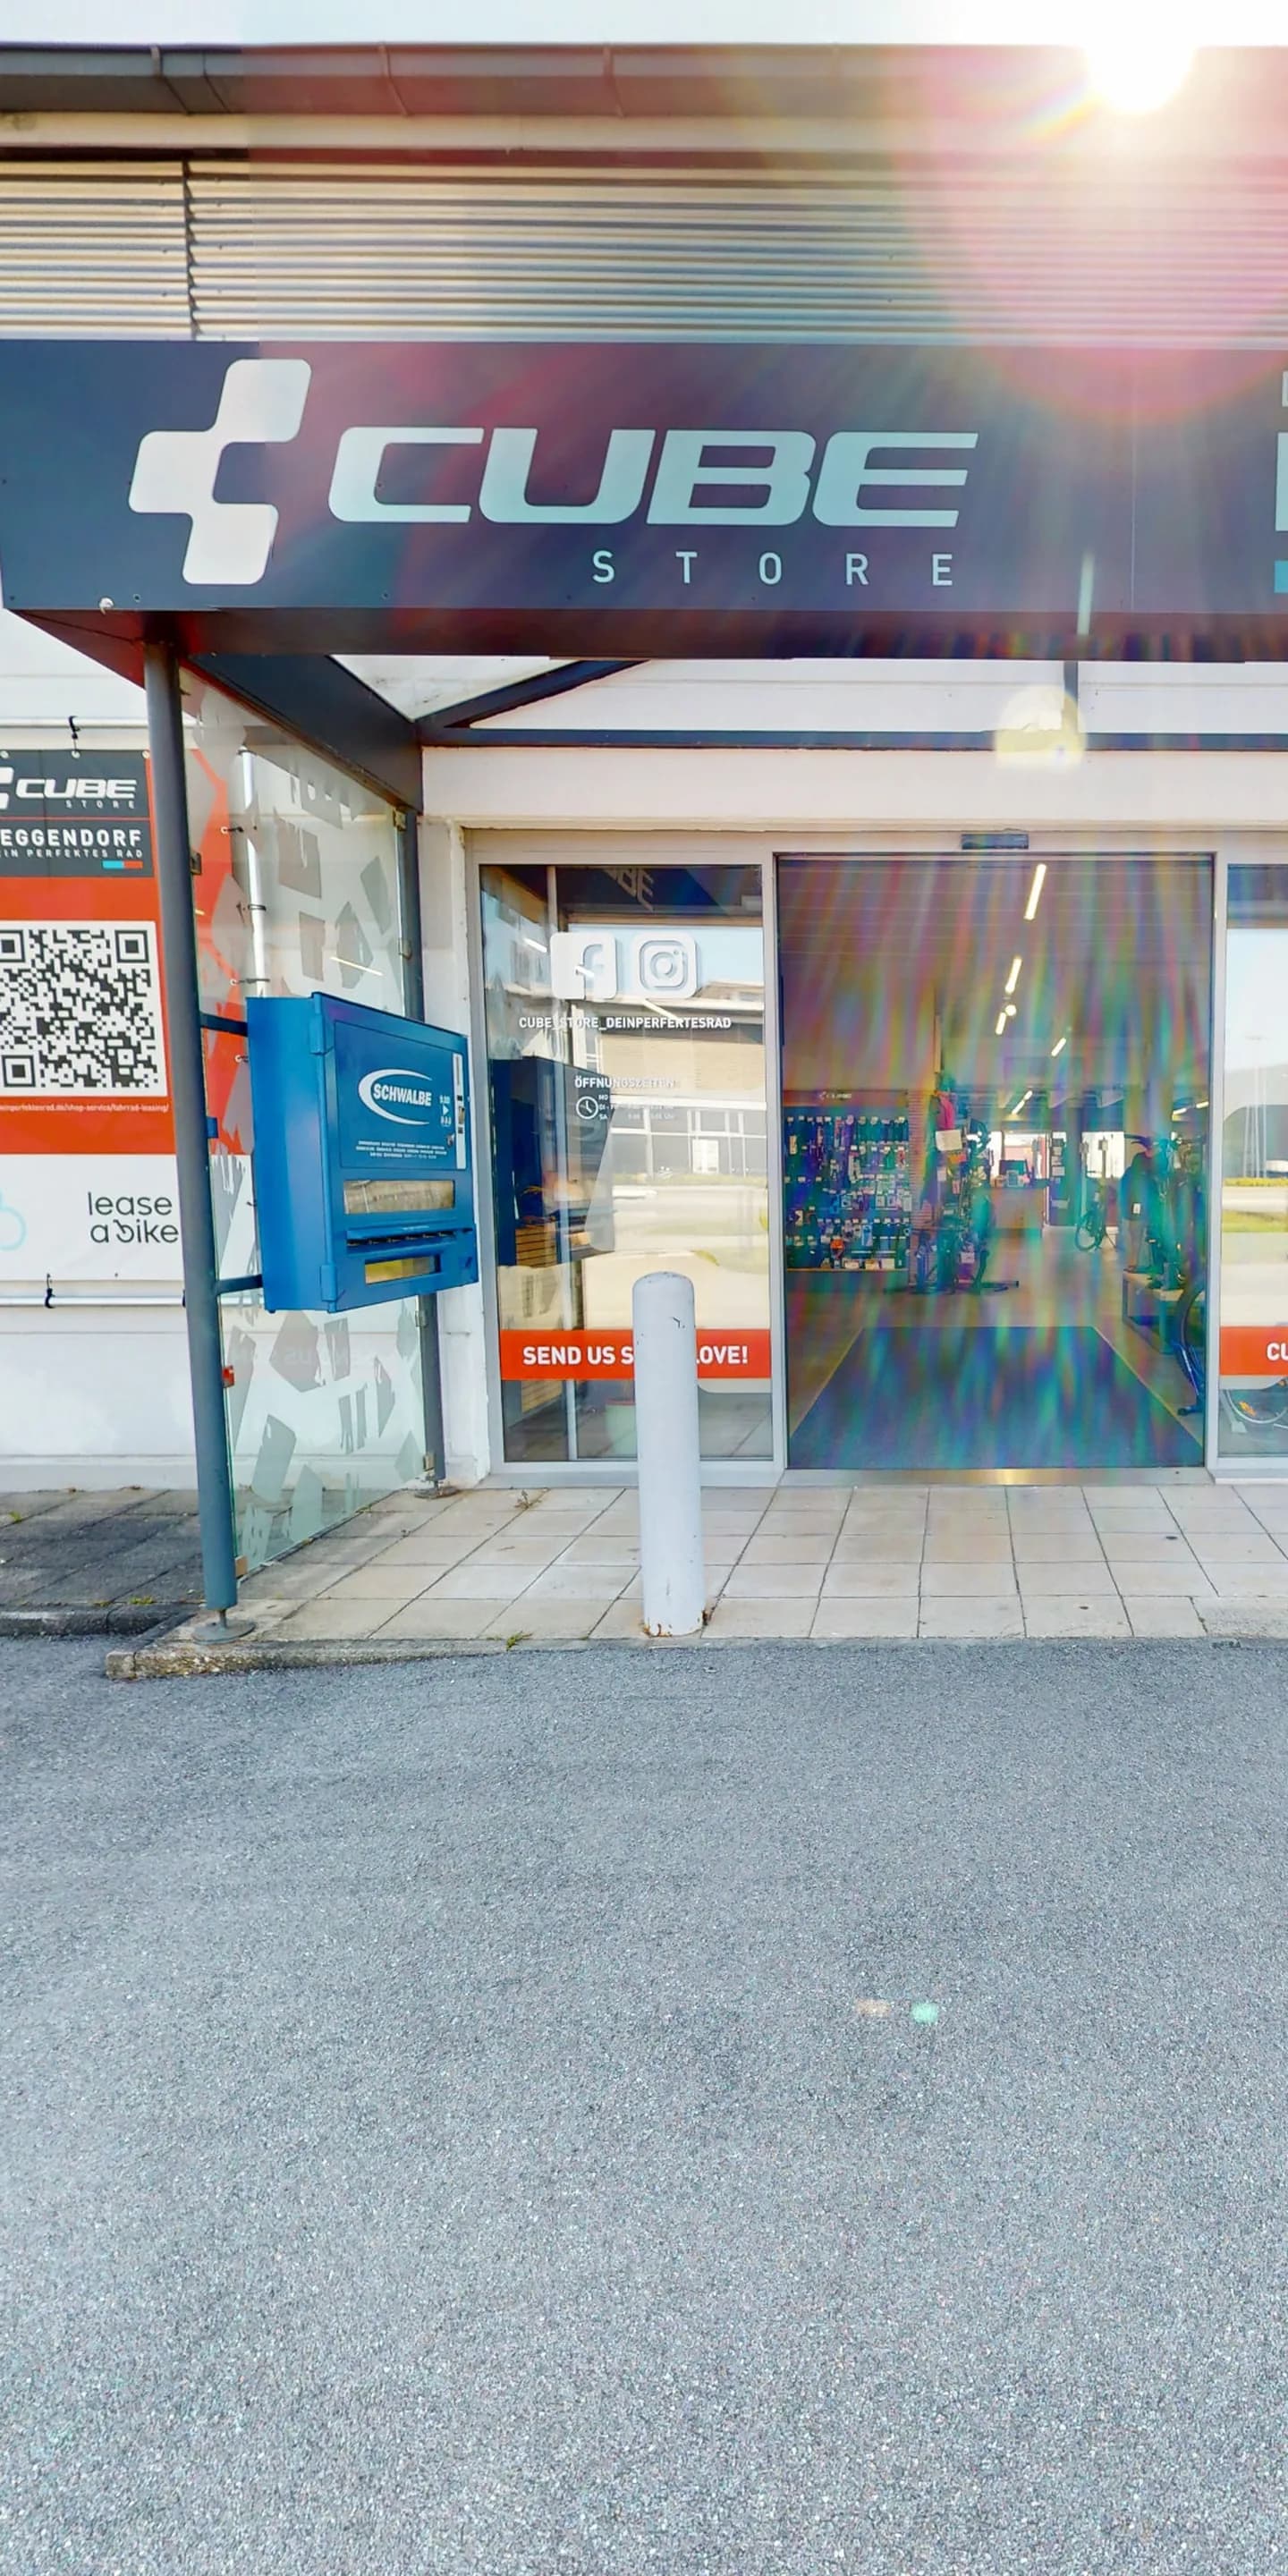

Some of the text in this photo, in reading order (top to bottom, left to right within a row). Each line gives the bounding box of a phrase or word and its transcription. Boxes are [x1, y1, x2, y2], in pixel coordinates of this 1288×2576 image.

[328, 427, 979, 528] CUBE
[592, 550, 953, 587] STORE
[15, 778, 137, 799] CUBE
[66, 800, 135, 809] STORE
[0, 828, 141, 847] EGGENDORF
[0, 849, 143, 858] IN PERFEKTES RAD
[373, 1083, 432, 1106] SCHWALBE
[88, 1191, 173, 1216] lease
[522, 1346, 581, 1365] SEND
[587, 1346, 616, 1364] US
[696, 1345, 749, 1364] OVE!
